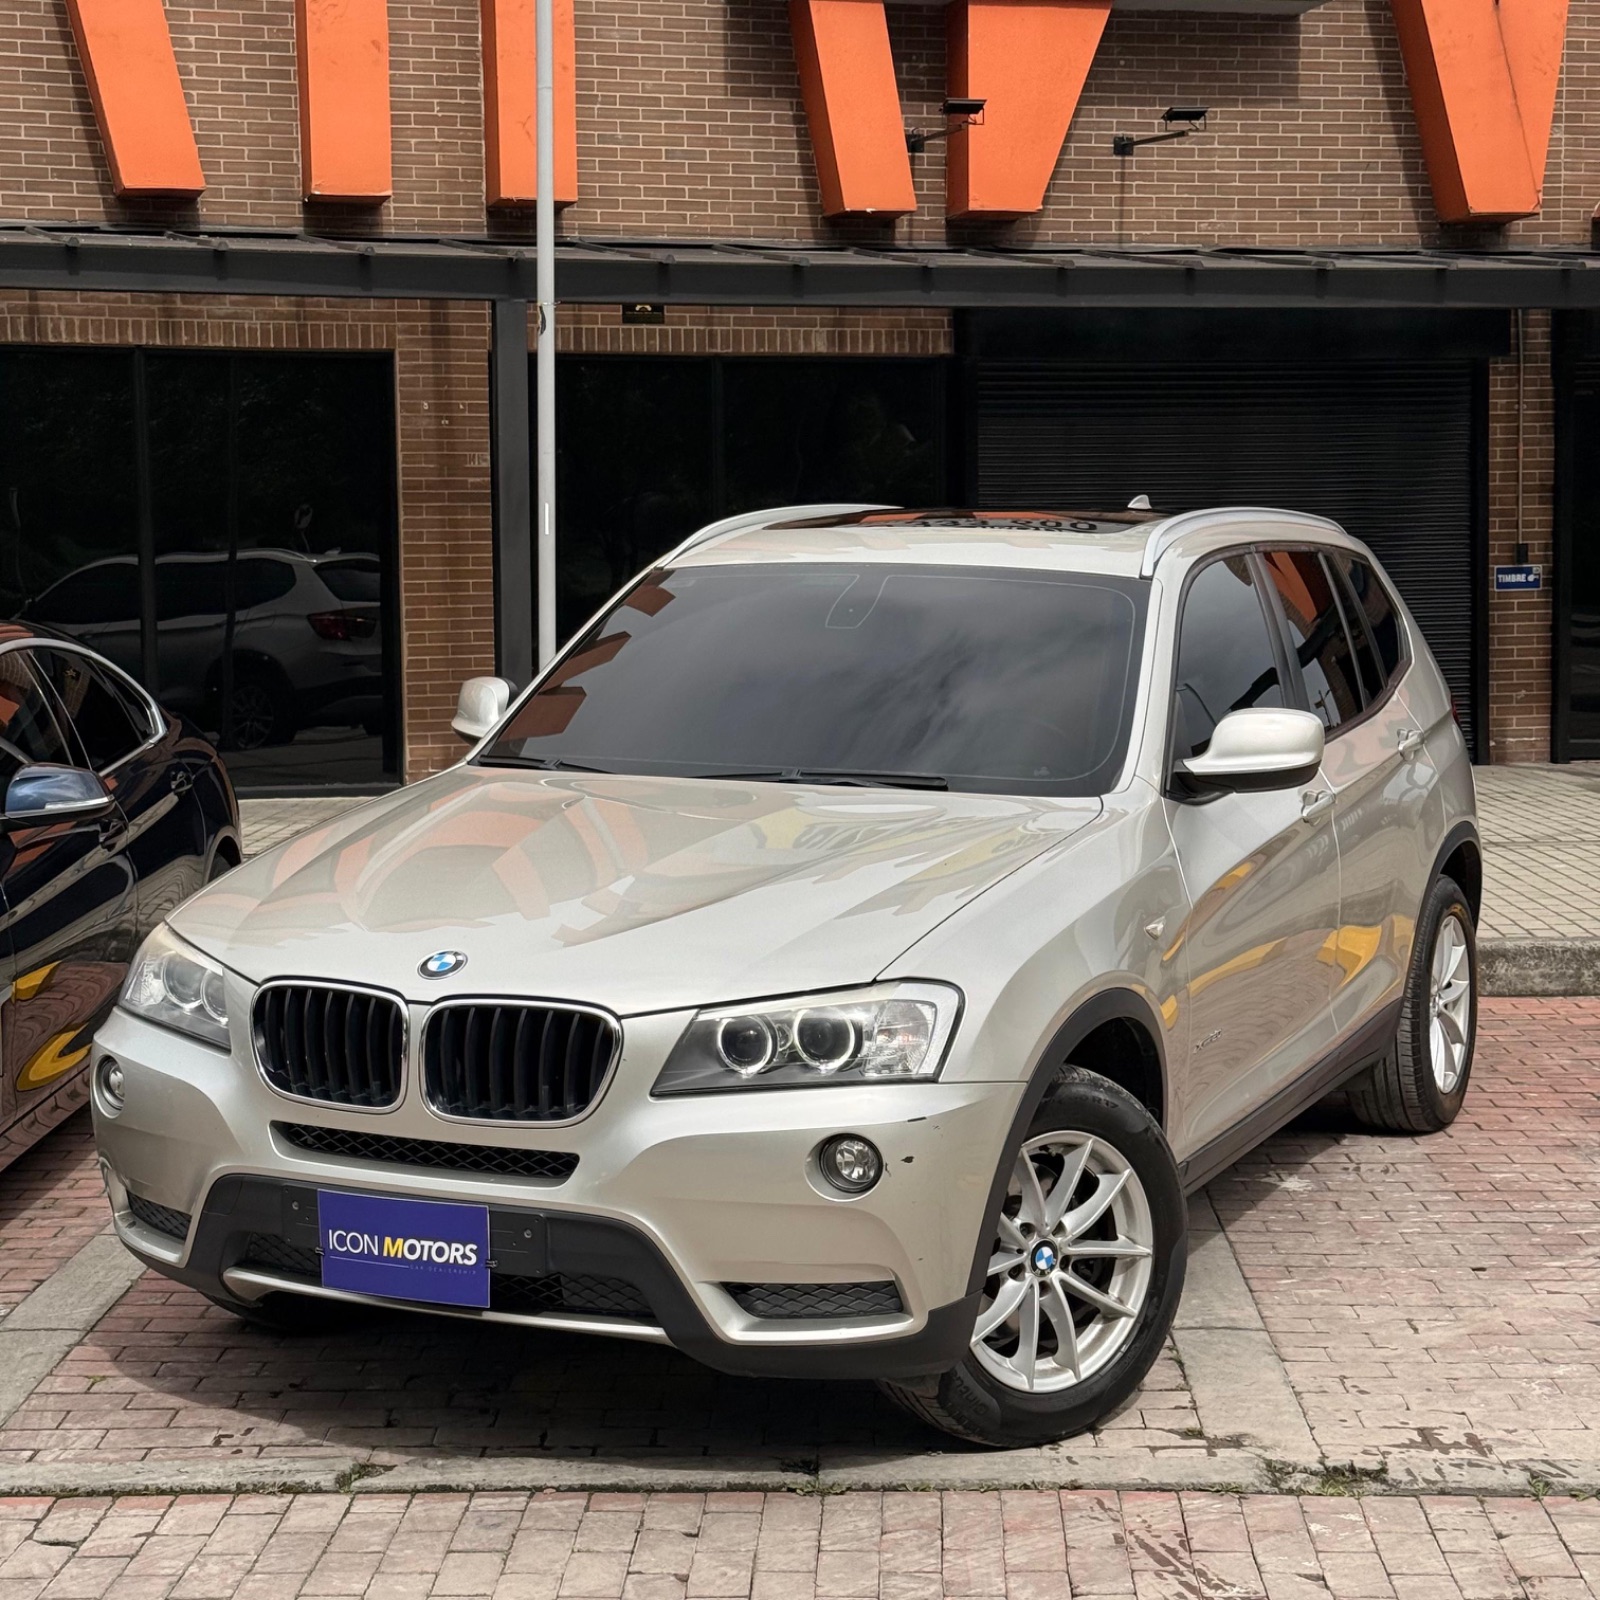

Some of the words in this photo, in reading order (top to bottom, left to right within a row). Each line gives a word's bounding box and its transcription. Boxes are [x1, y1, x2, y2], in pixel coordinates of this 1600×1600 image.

[1497, 574, 1526, 583] TIMBRE
[328, 1229, 378, 1256] ICON
[382, 1236, 478, 1266] MOTORS
